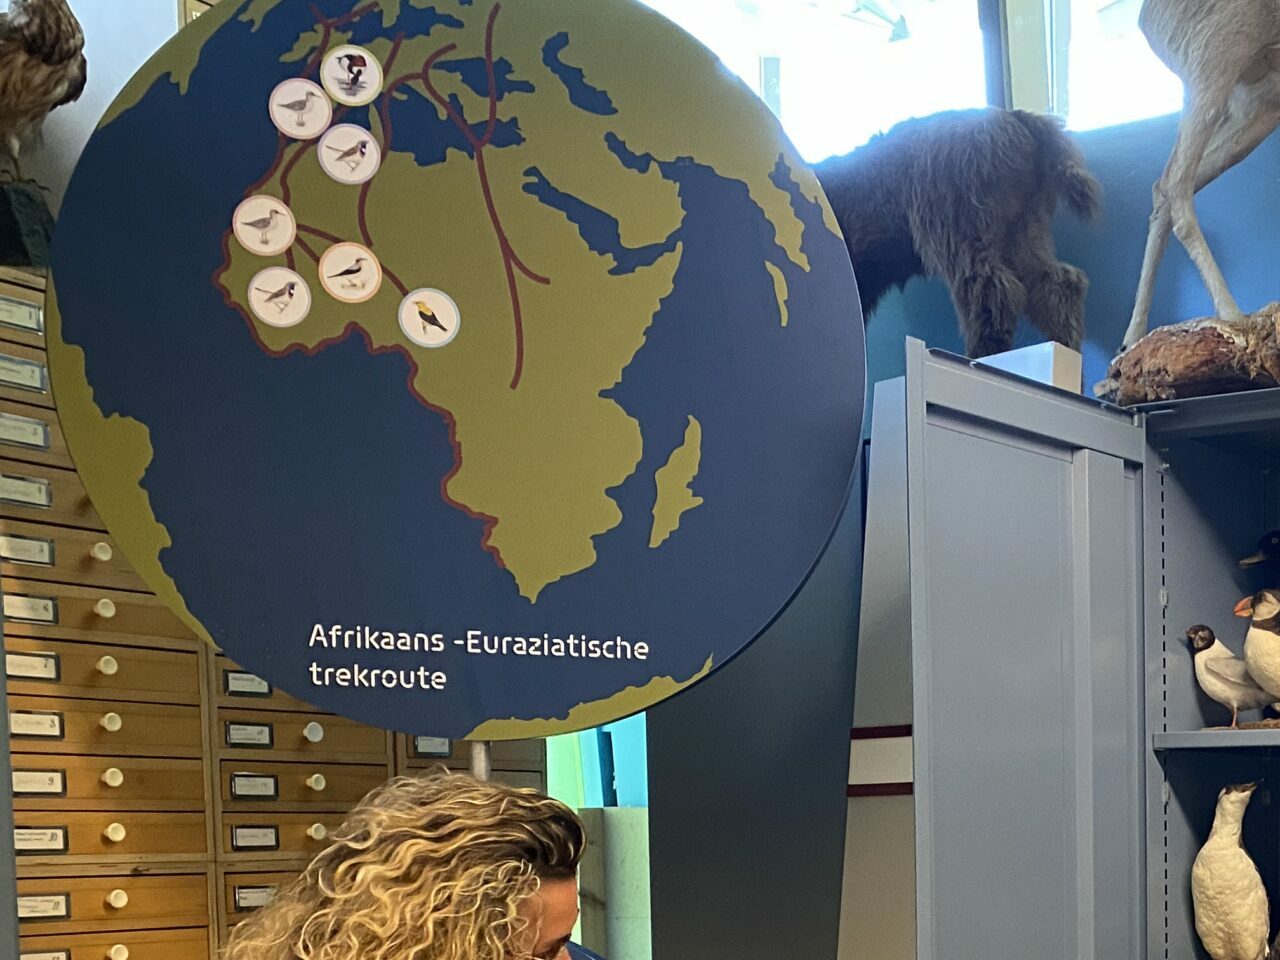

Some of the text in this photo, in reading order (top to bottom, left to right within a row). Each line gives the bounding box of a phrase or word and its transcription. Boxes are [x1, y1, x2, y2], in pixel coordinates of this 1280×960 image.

[309, 624, 444, 651] Afrikaans
[309, 661, 447, 690] trekroute
[48, 777, 54, 786] 9
